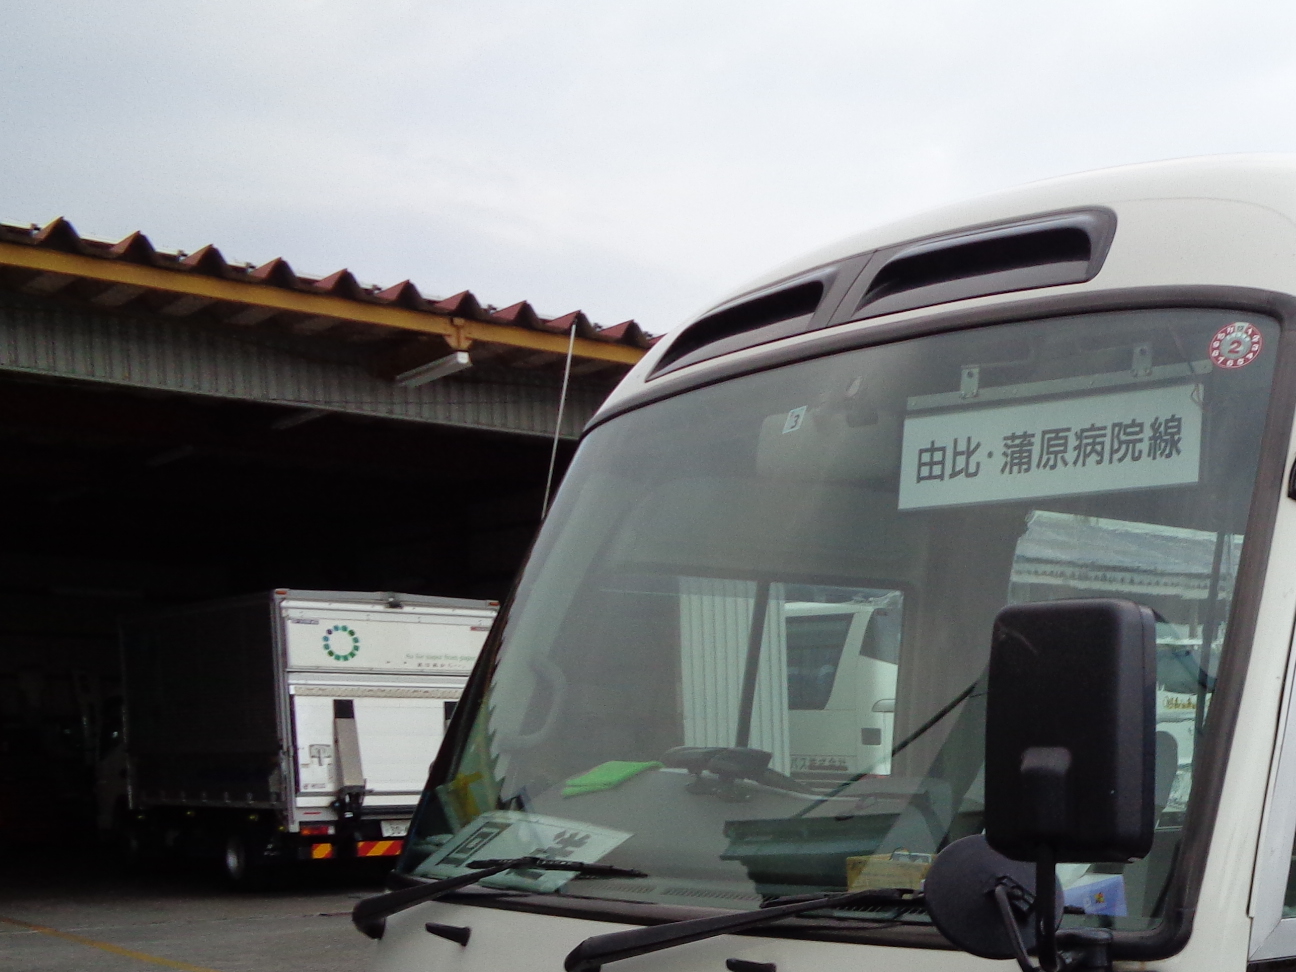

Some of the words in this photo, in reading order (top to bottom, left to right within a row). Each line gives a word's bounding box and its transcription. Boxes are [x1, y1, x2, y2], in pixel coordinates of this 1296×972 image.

[916, 414, 1184, 484] 由比・蒲原病院線
